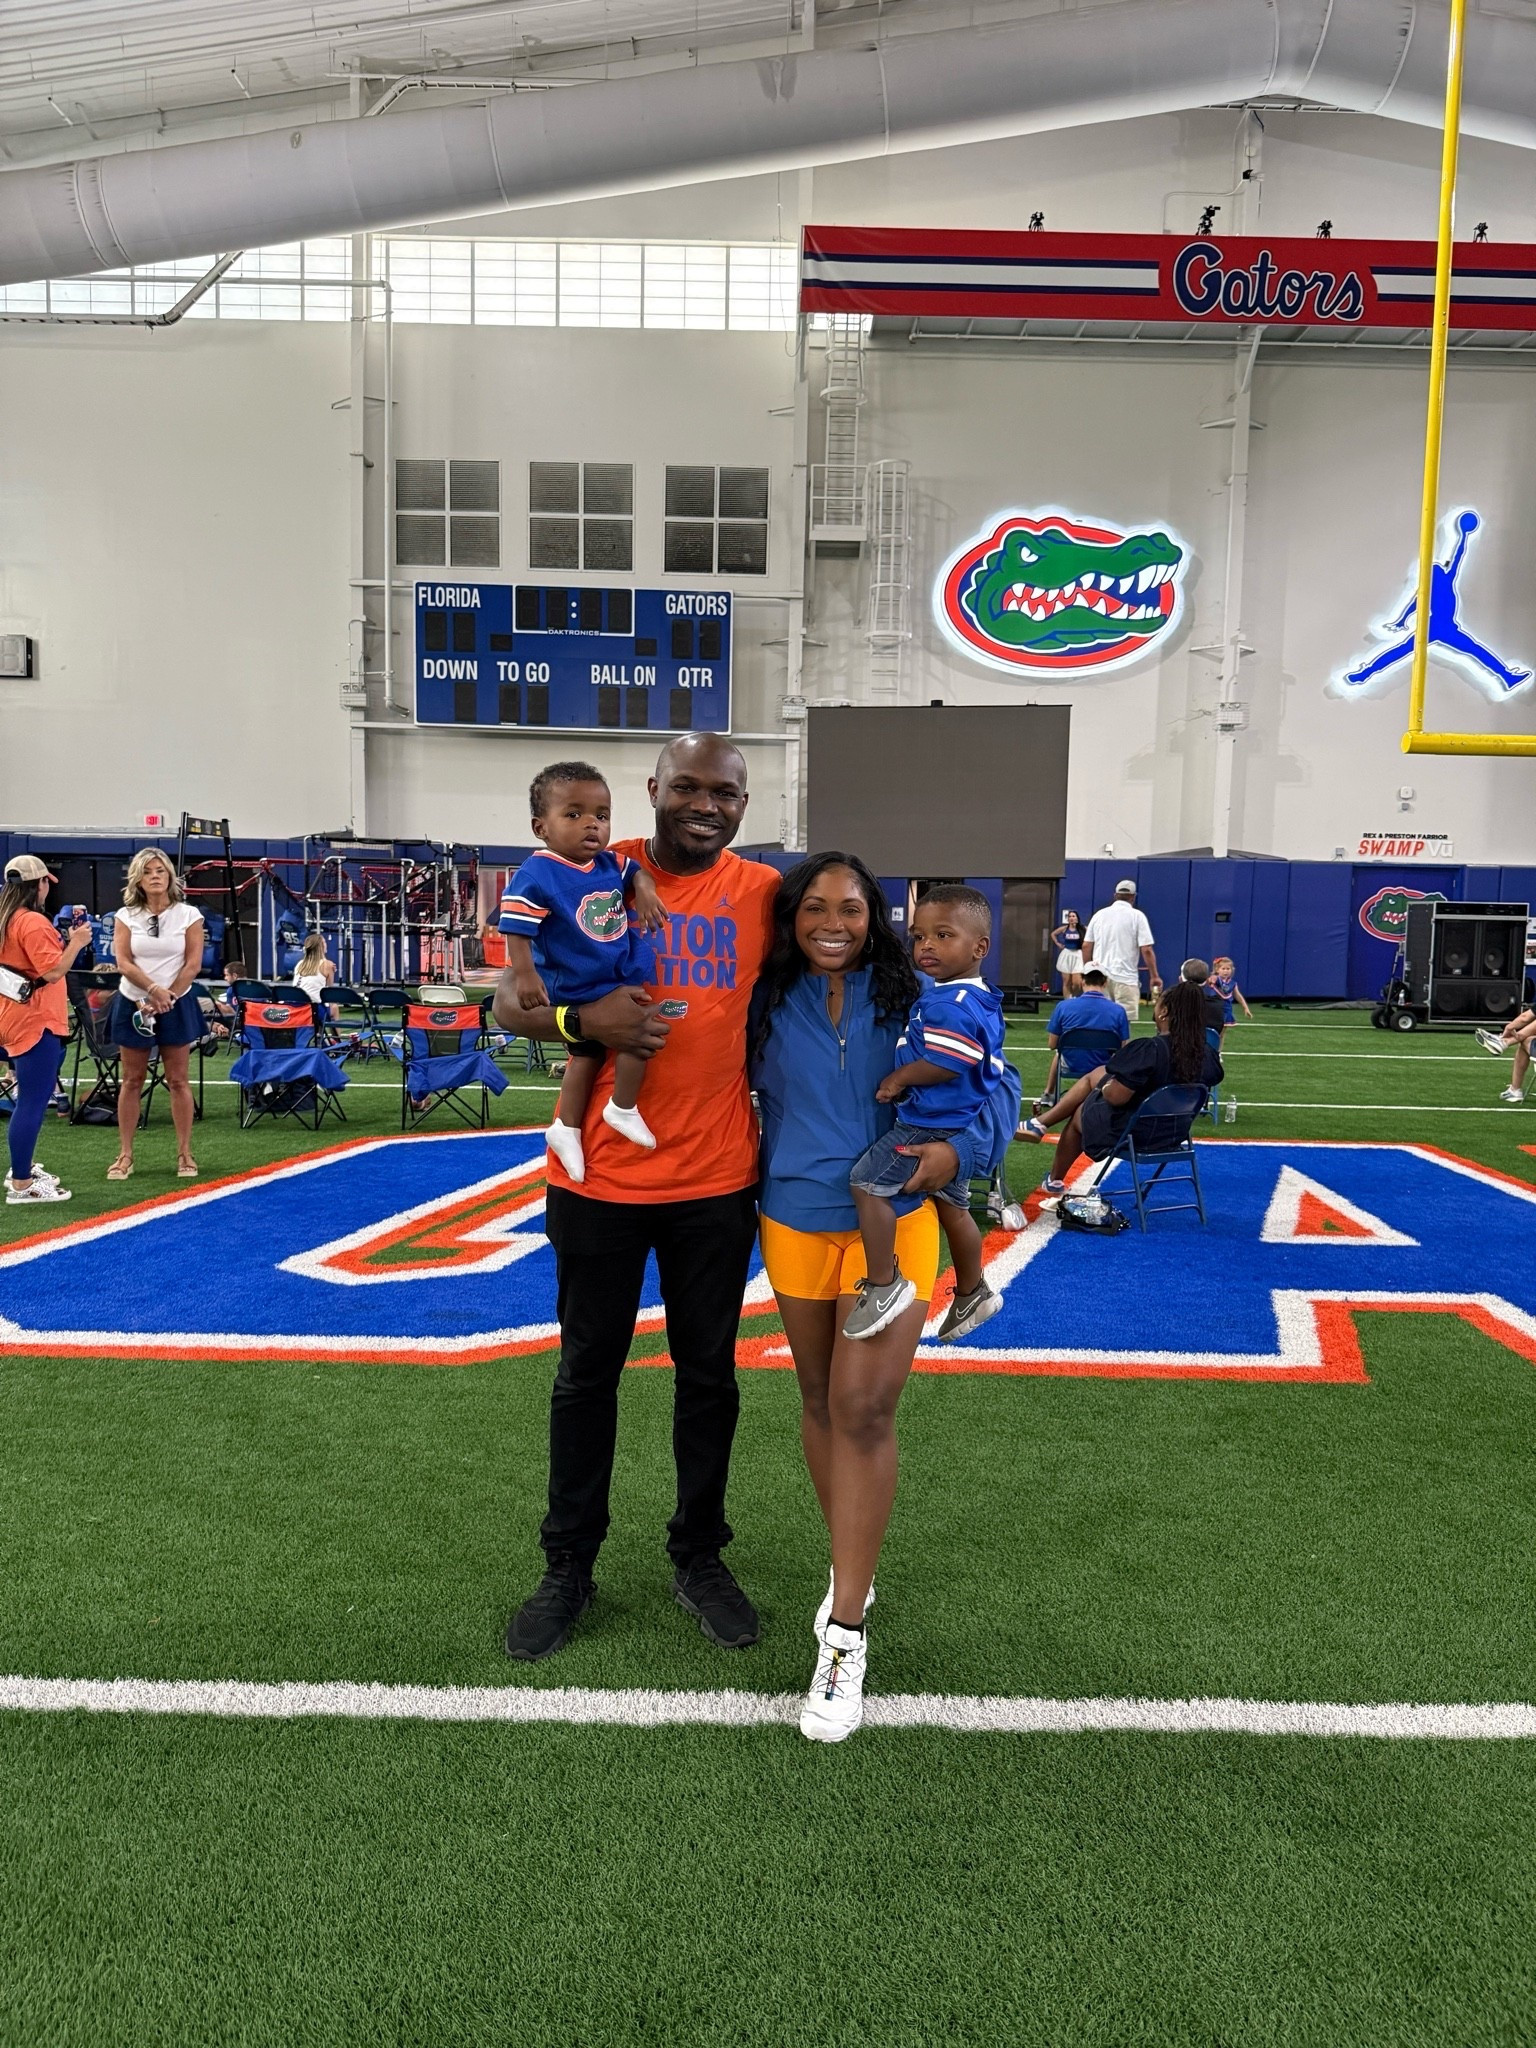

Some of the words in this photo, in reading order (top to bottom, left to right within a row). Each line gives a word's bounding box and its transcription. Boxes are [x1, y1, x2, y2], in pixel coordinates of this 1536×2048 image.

[1173, 242, 1364, 321] Gators
[418, 586, 481, 608] FLORIDA
[665, 594, 727, 616] GATORS
[423, 658, 478, 681] DOWN
[497, 661, 519, 682] TO
[525, 662, 550, 683] GO
[591, 664, 629, 685] BALL
[633, 666, 656, 686] ON
[678, 667, 713, 688] QTR
[1358, 840, 1425, 856] SWAMP
[627, 910, 737, 959] ATOR
[648, 958, 736, 989] TION
[955, 989, 968, 1003] 1
